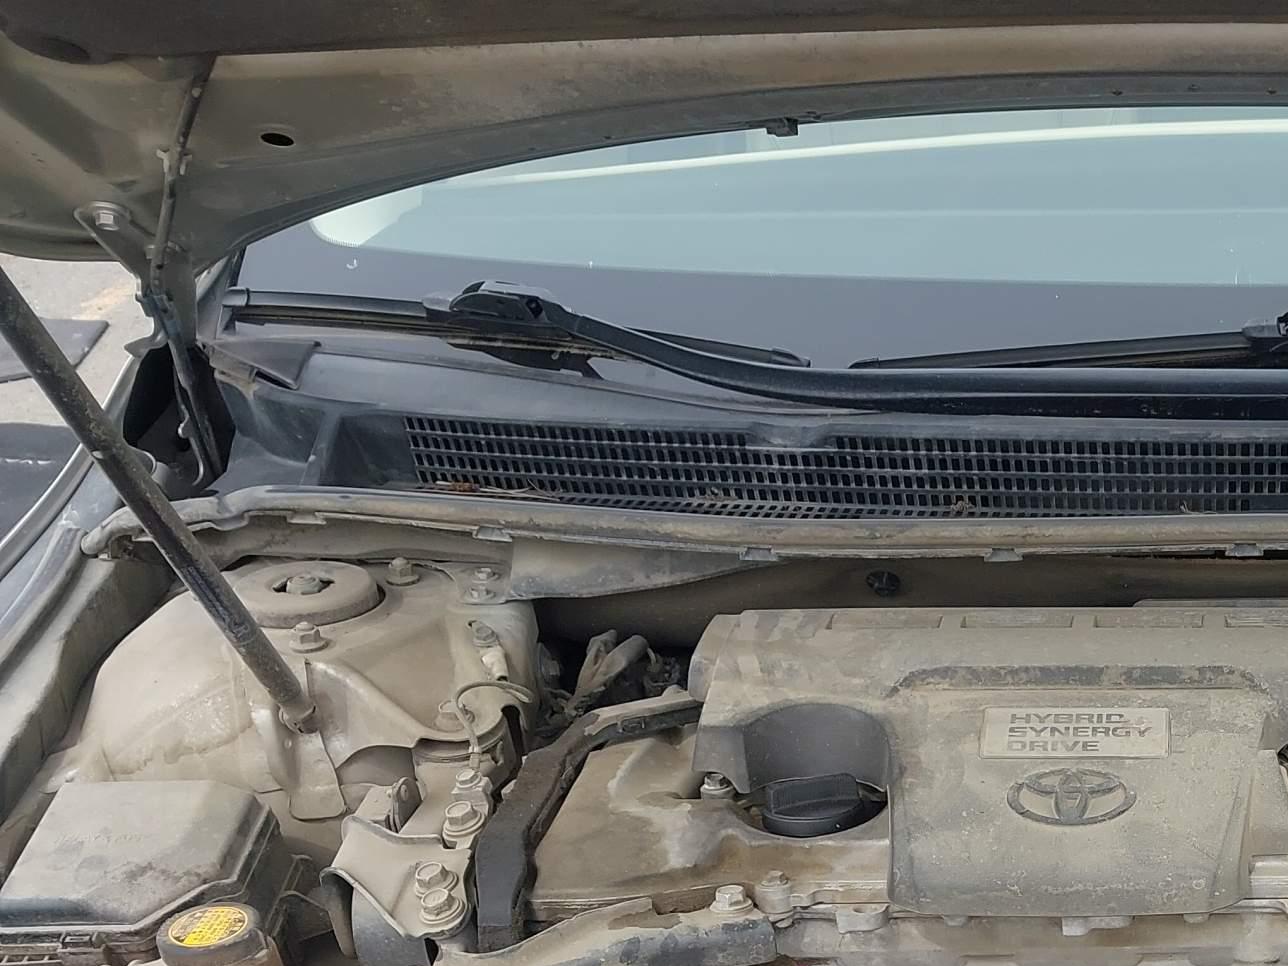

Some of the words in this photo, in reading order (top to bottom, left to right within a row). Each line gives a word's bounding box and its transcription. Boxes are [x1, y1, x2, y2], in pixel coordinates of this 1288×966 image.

[1010, 713, 1128, 724] HYBRID
[1007, 726, 1152, 738] SYNERGY
[1006, 740, 1100, 752] DRIVE
